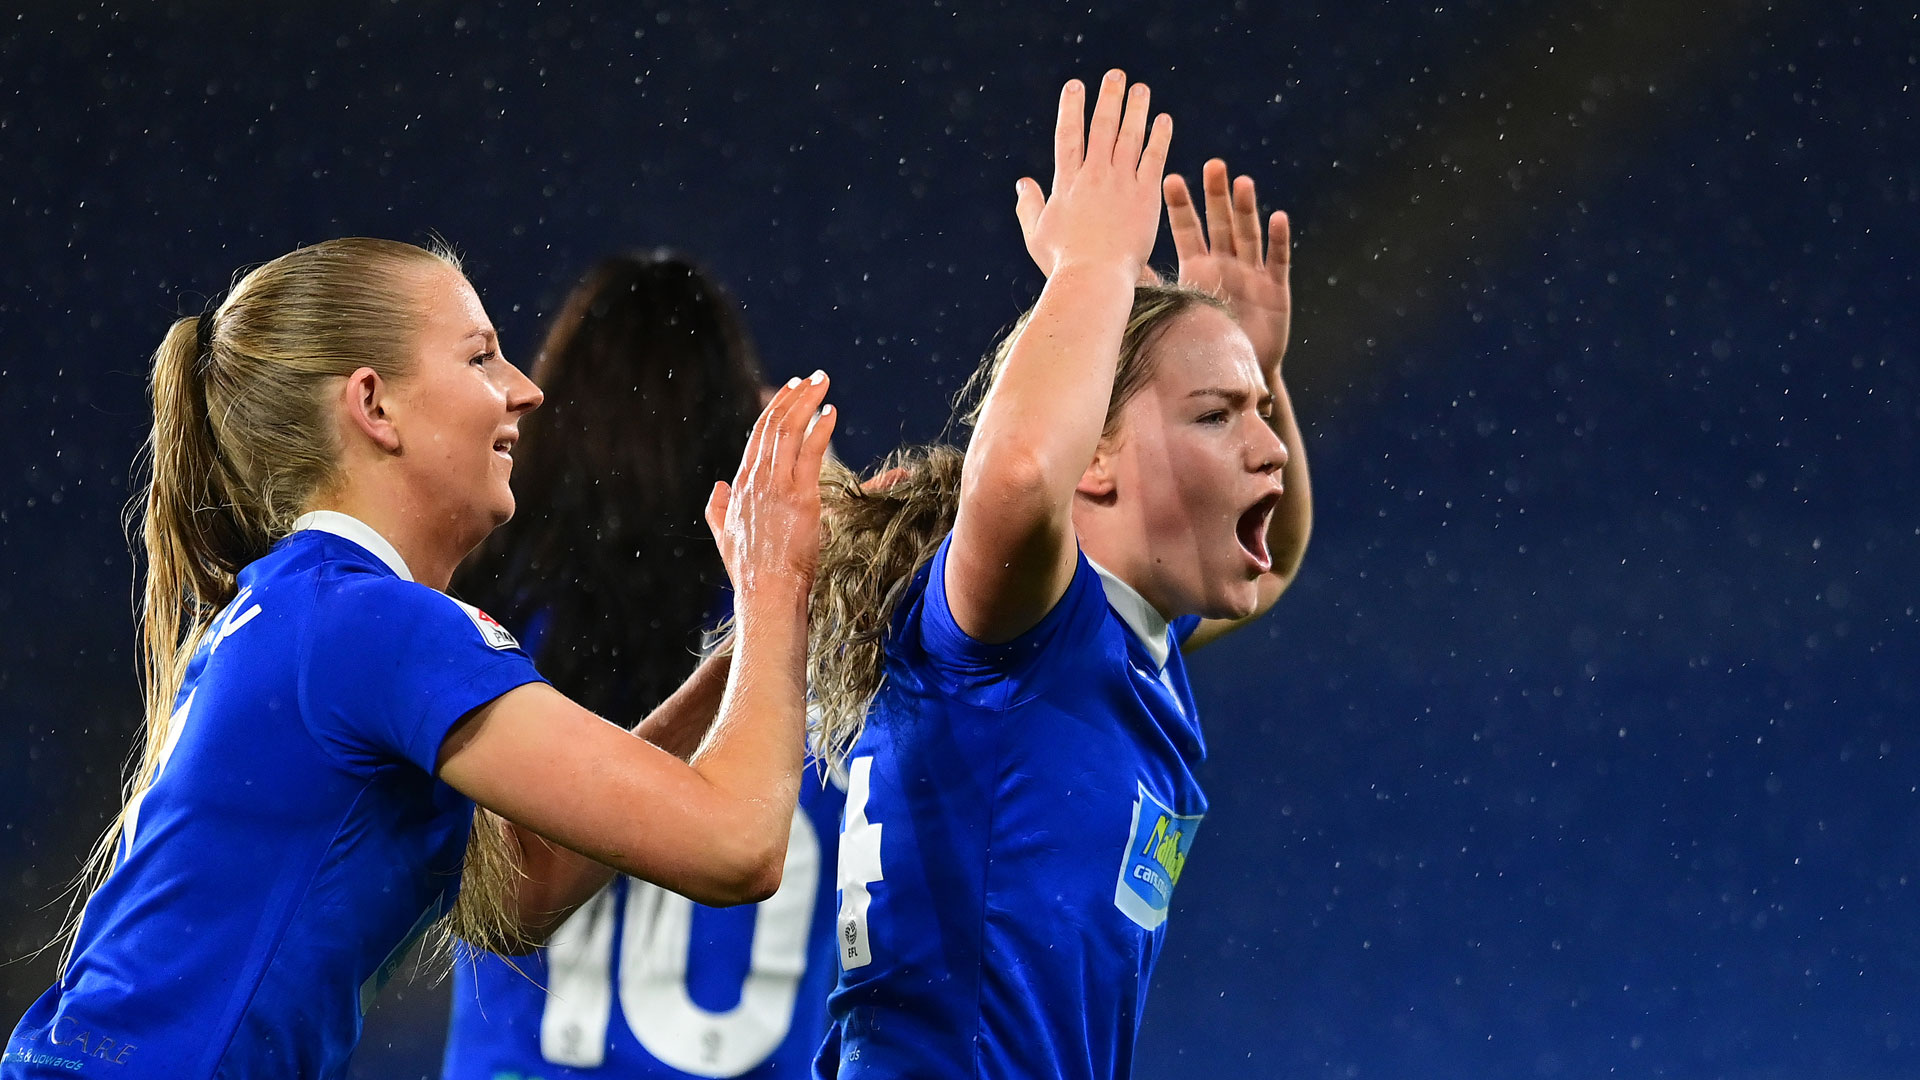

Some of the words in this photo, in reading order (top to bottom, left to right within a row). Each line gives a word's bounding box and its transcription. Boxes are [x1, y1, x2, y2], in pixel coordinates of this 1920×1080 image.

[541, 801, 822, 1078] 10
[847, 946, 859, 959] EFL
[32, 1053, 84, 1071] upwards
